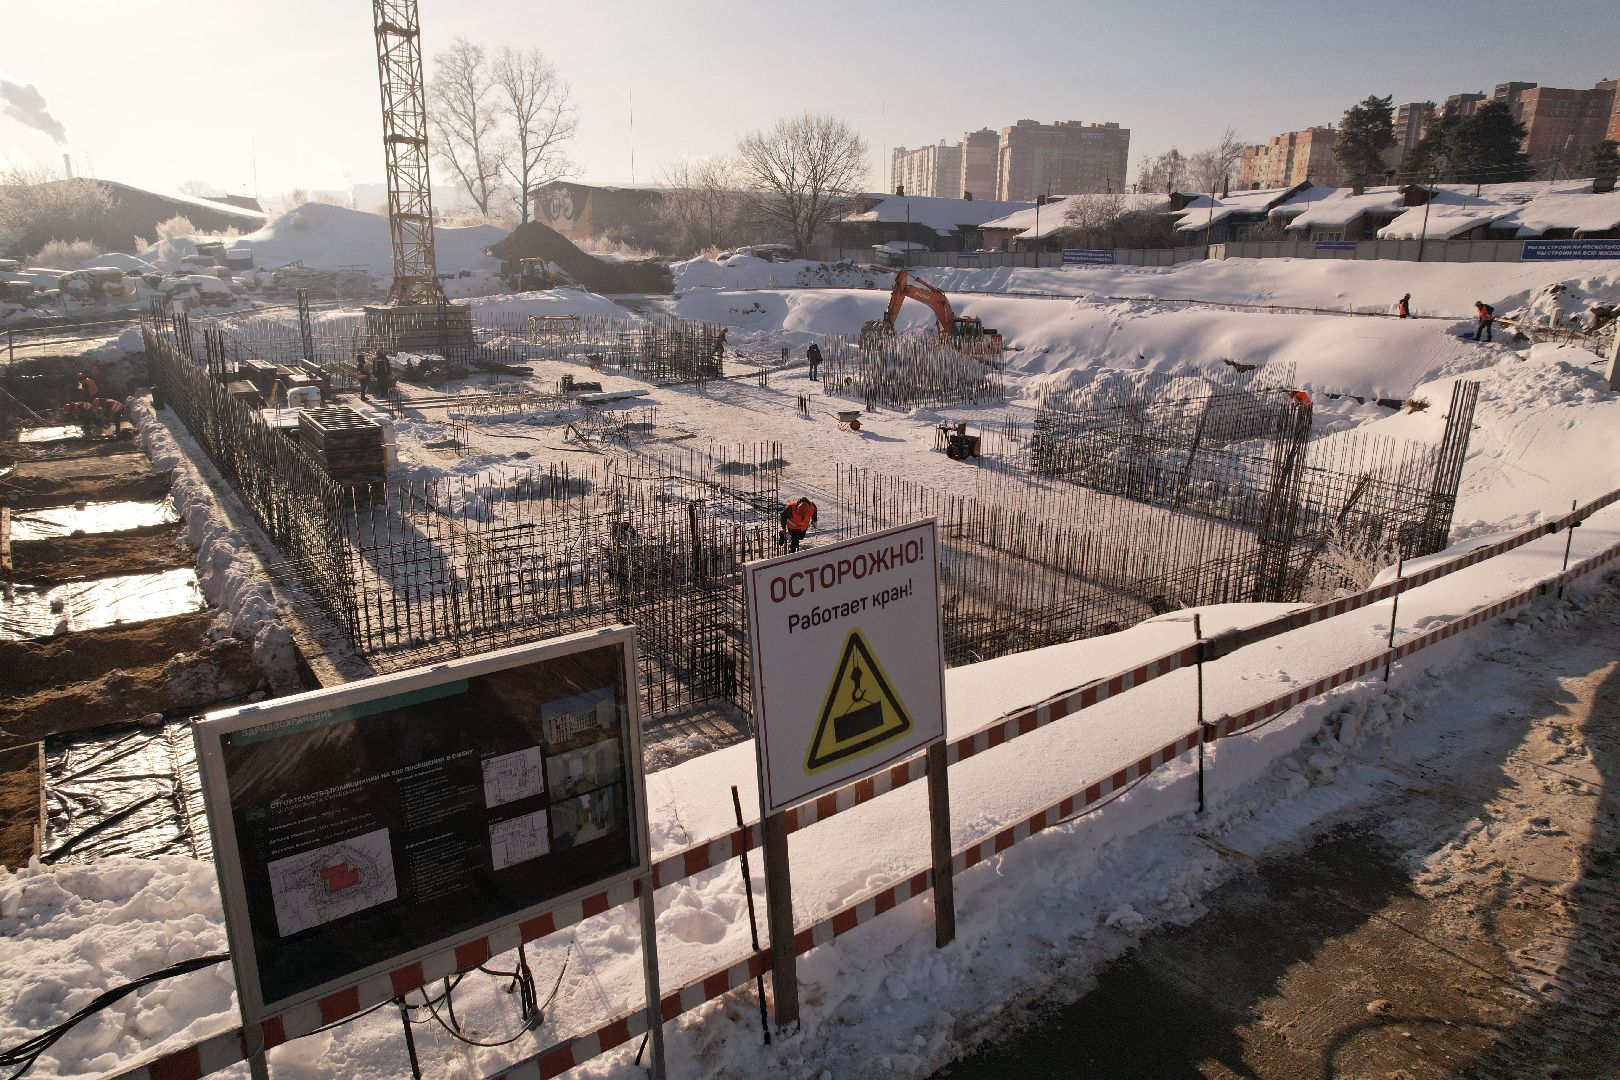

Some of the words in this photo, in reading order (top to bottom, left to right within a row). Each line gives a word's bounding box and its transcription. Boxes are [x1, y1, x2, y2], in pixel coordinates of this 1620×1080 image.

[770, 536, 924, 604] ОСТОРОЖНО!
[788, 597, 868, 634] Работает
[872, 577, 913, 609] кран!
[271, 789, 331, 809] СТРОИТЕЛЬСТВО
